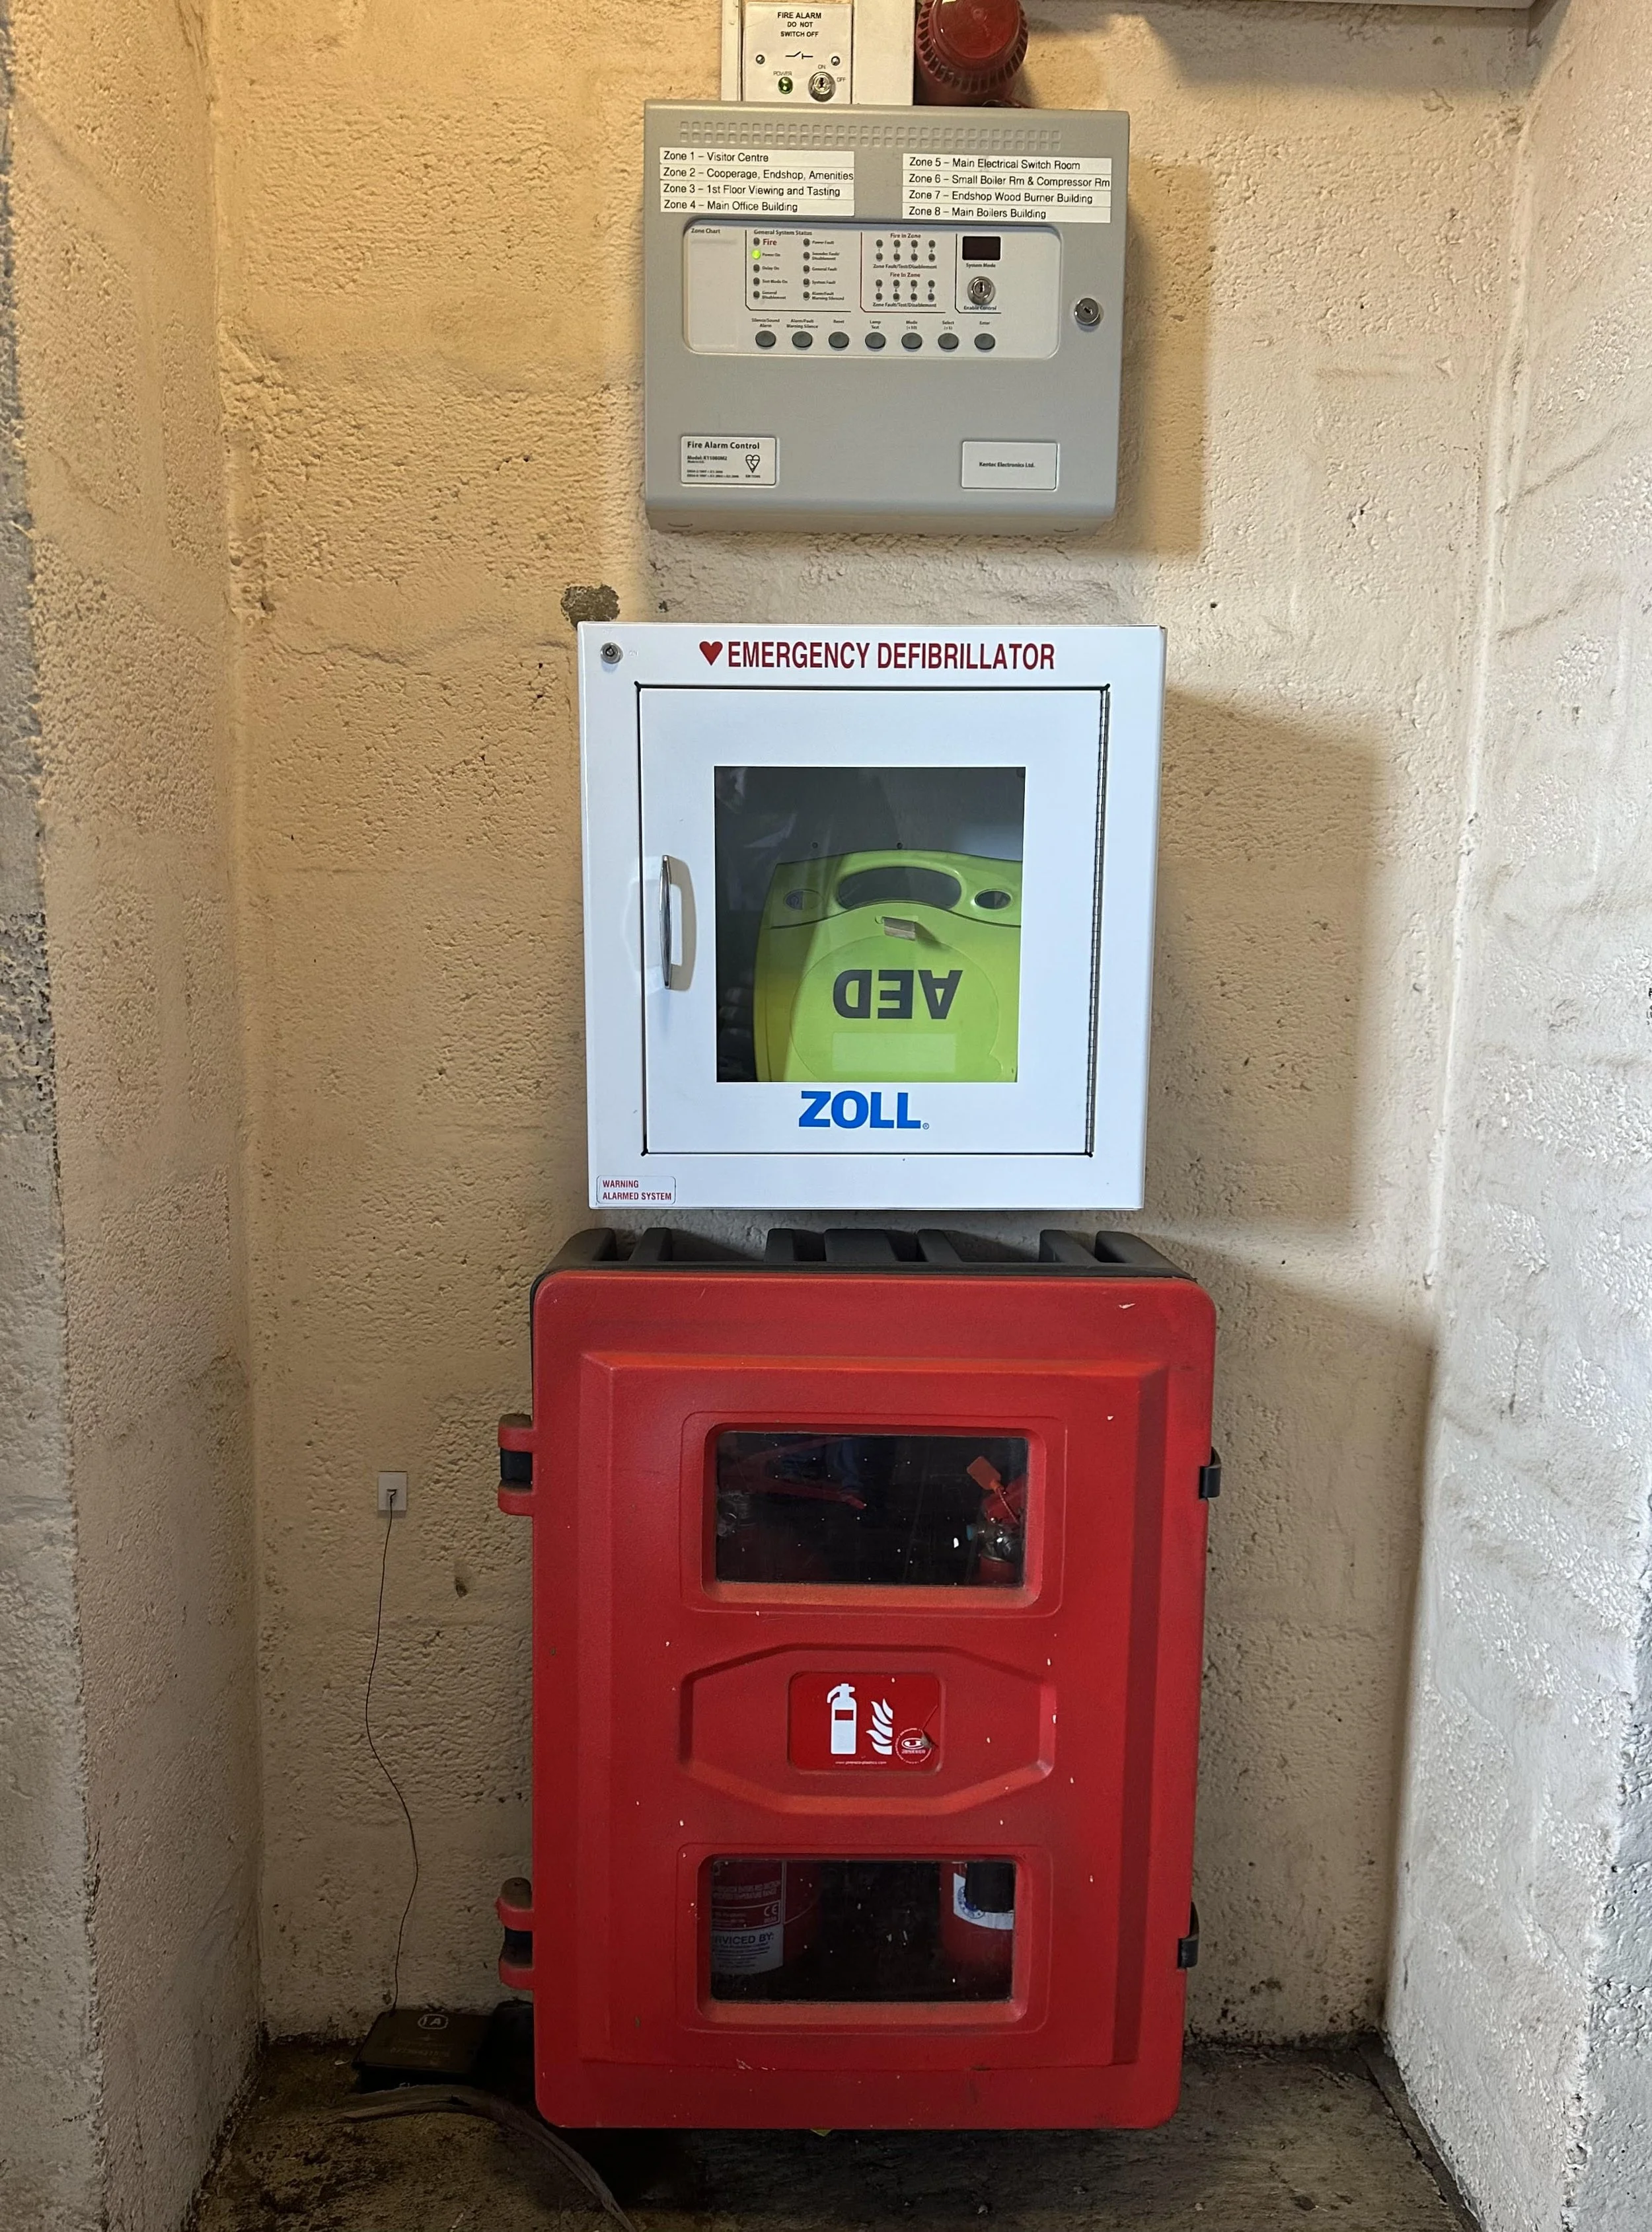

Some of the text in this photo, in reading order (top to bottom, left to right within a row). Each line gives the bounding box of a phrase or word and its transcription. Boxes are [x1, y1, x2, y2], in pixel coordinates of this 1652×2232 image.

[664, 151, 687, 160] Zone
[707, 152, 735, 162] Visitor
[738, 153, 769, 162] Centre
[909, 157, 932, 167] Zone
[935, 157, 941, 167] 5
[952, 159, 975, 168] Main
[978, 159, 1018, 168] Electrical
[1022, 159, 1051, 169] Switch
[1055, 161, 1080, 170] Room
[663, 168, 687, 176] Zone
[690, 168, 695, 176] 2
[706, 168, 760, 179] Cooperage,
[763, 170, 806, 180] Endshop,
[809, 170, 854, 180] Amenities
[909, 174, 932, 183] Zone
[935, 174, 940, 183] 6
[952, 175, 977, 184] Small
[981, 176, 1006, 185] Boiler
[1010, 176, 1025, 185] Rm
[1028, 176, 1034, 186] &
[1037, 177, 1092, 187] Compressor
[1095, 178, 1110, 187] Rm
[663, 184, 687, 193] Zone
[689, 184, 695, 193] 3
[708, 185, 720, 194] 1st
[724, 185, 746, 194] Floor
[749, 186, 784, 196] Viewing
[787, 186, 804, 196] and
[807, 187, 841, 197] Tasting
[909, 190, 932, 200] Zone
[935, 190, 940, 200] 7
[952, 191, 992, 202] Endshop
[995, 192, 1021, 201] Wood
[1024, 193, 1054, 202] Burner
[1057, 194, 1093, 204] Building
[664, 200, 687, 209] Zone
[690, 200, 695, 209] 4
[707, 201, 730, 209] Main
[732, 202, 759, 211] Office
[762, 202, 798, 212] Building
[909, 206, 932, 215] Zone
[935, 207, 940, 215] 8
[952, 207, 974, 216] Main
[977, 207, 1007, 217] Boilers
[1010, 208, 1046, 219] Building
[728, 641, 1055, 670] EMERGENCY DEFIBRILLATOR
[833, 969, 963, 1020] AED
[759, 1932, 774, 1943] BY:
